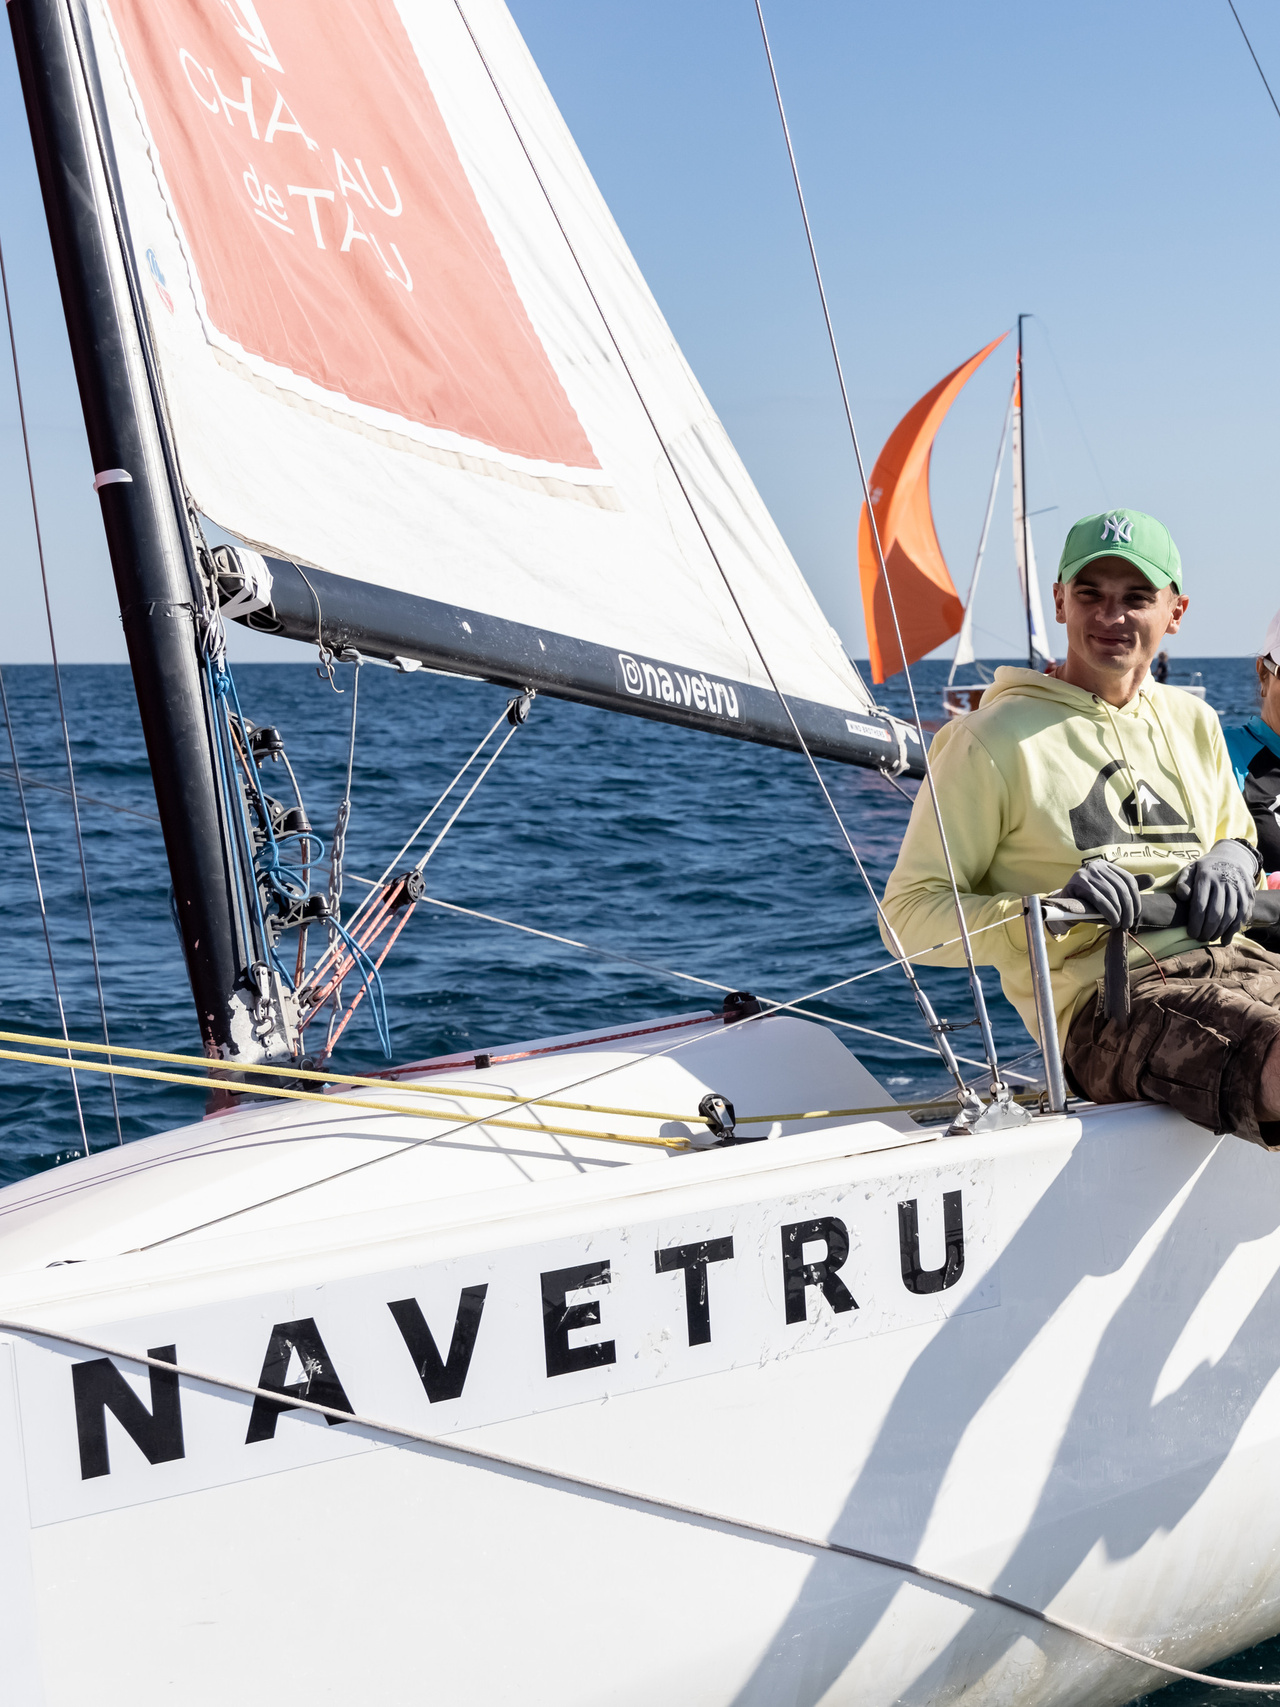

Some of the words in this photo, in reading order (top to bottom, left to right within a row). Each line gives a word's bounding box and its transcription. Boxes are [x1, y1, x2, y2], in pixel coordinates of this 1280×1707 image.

[179, 48, 402, 217] CHAAU
[1100, 515, 1134, 542] NY
[641, 662, 739, 718] na.vetru
[956, 693, 971, 712] 3
[71, 1190, 964, 1481] NAVETRU
